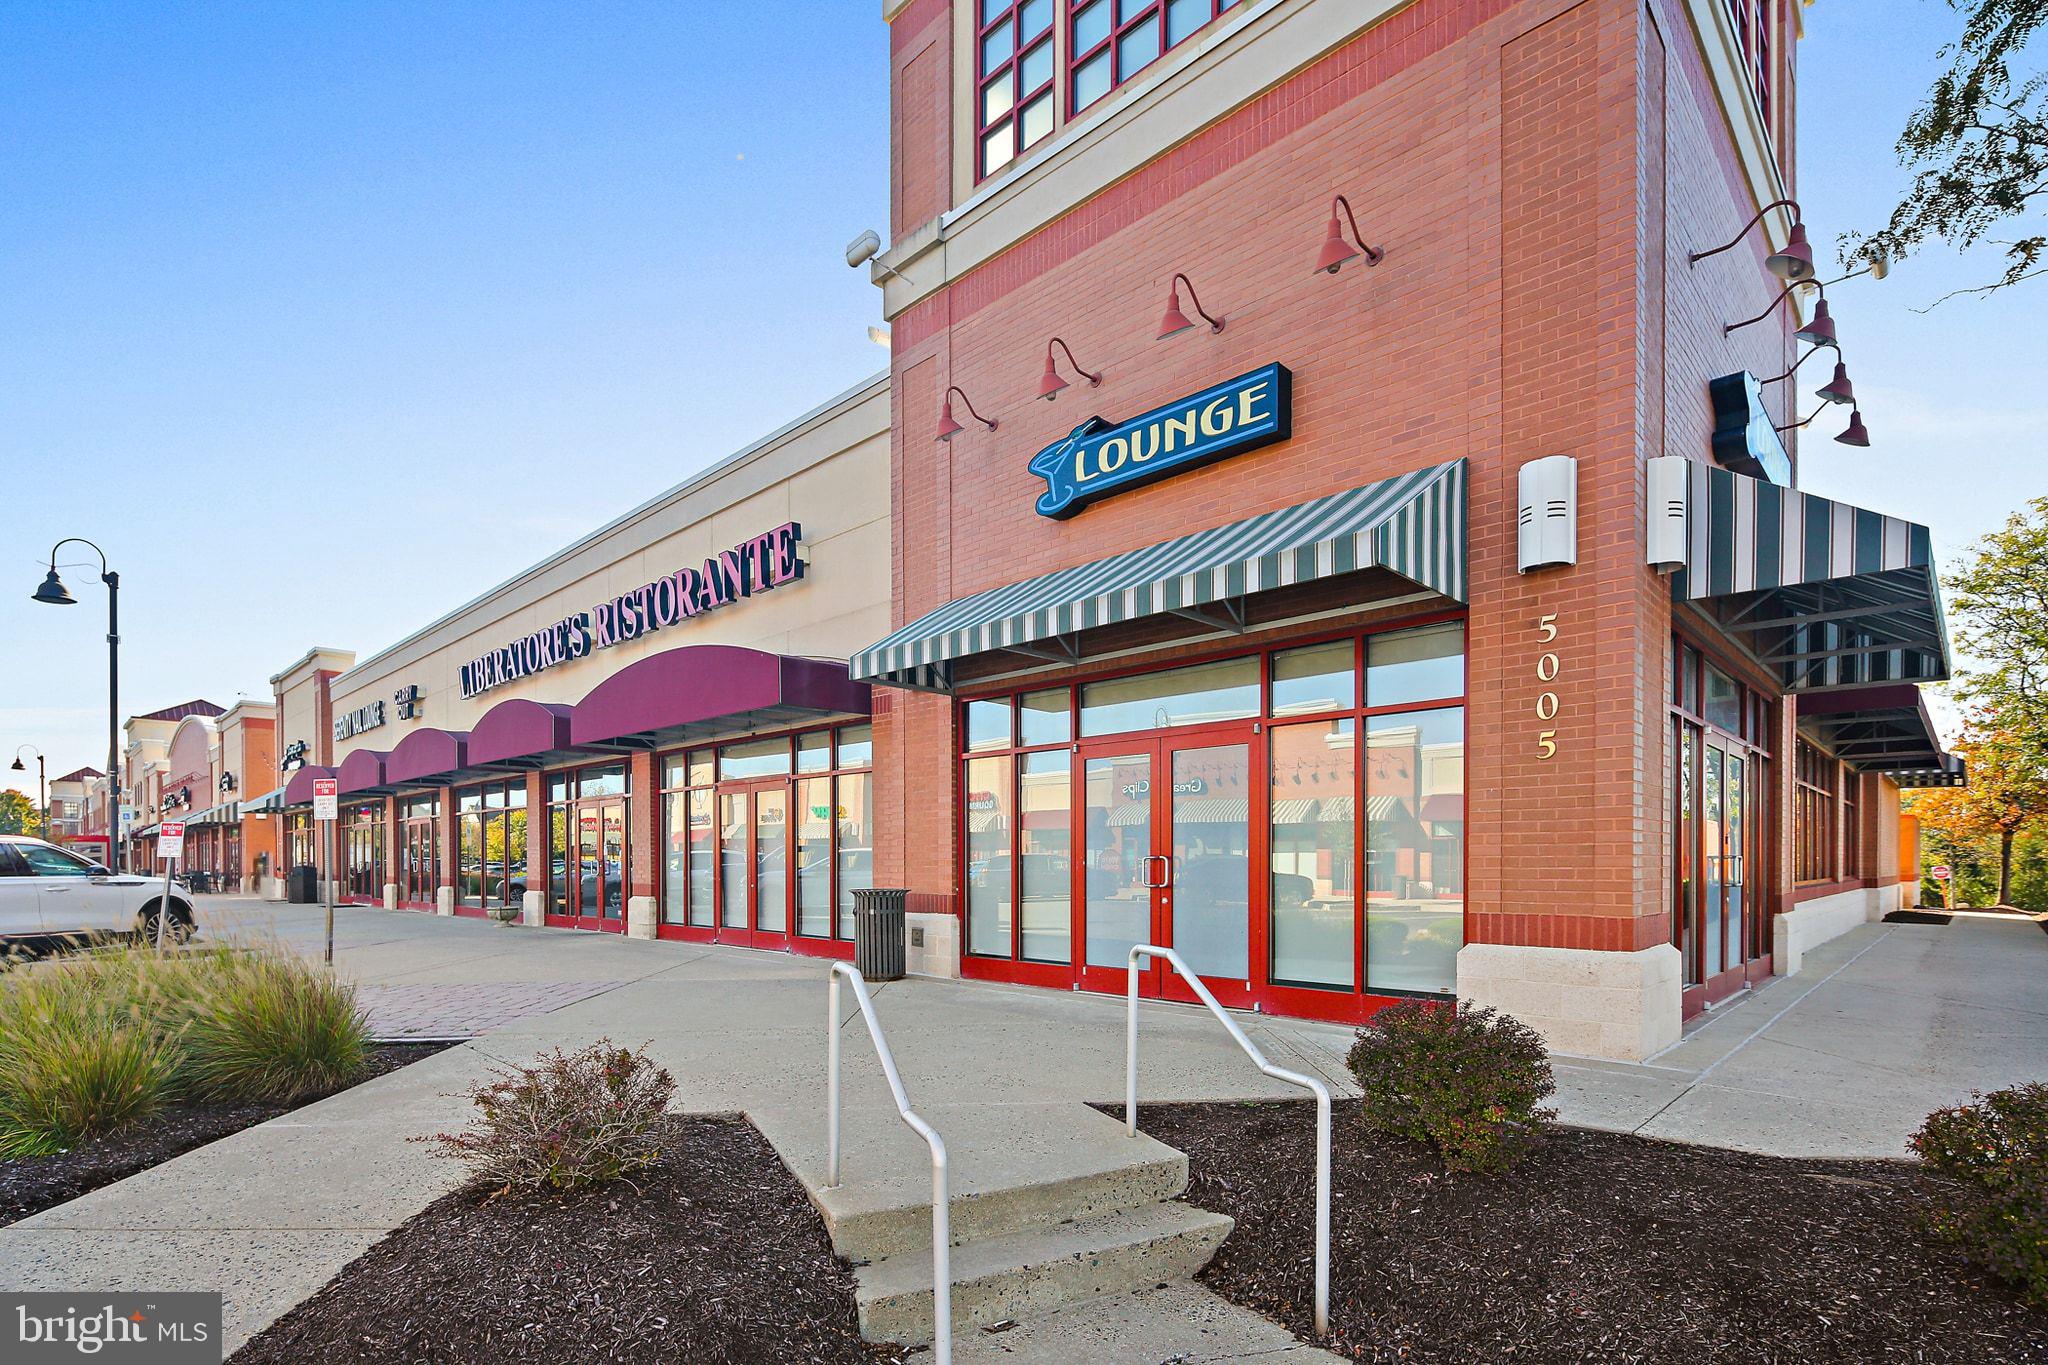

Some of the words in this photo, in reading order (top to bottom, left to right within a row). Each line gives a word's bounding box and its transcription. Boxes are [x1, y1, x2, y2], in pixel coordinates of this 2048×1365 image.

[1075, 381, 1271, 483] LOUNGE
[457, 613, 591, 701] LIBERATORE'S
[593, 522, 803, 650] RISTORANTE
[394, 685, 416, 705] CARRY
[398, 703, 413, 720] OUT
[1536, 612, 1560, 760] 5005
